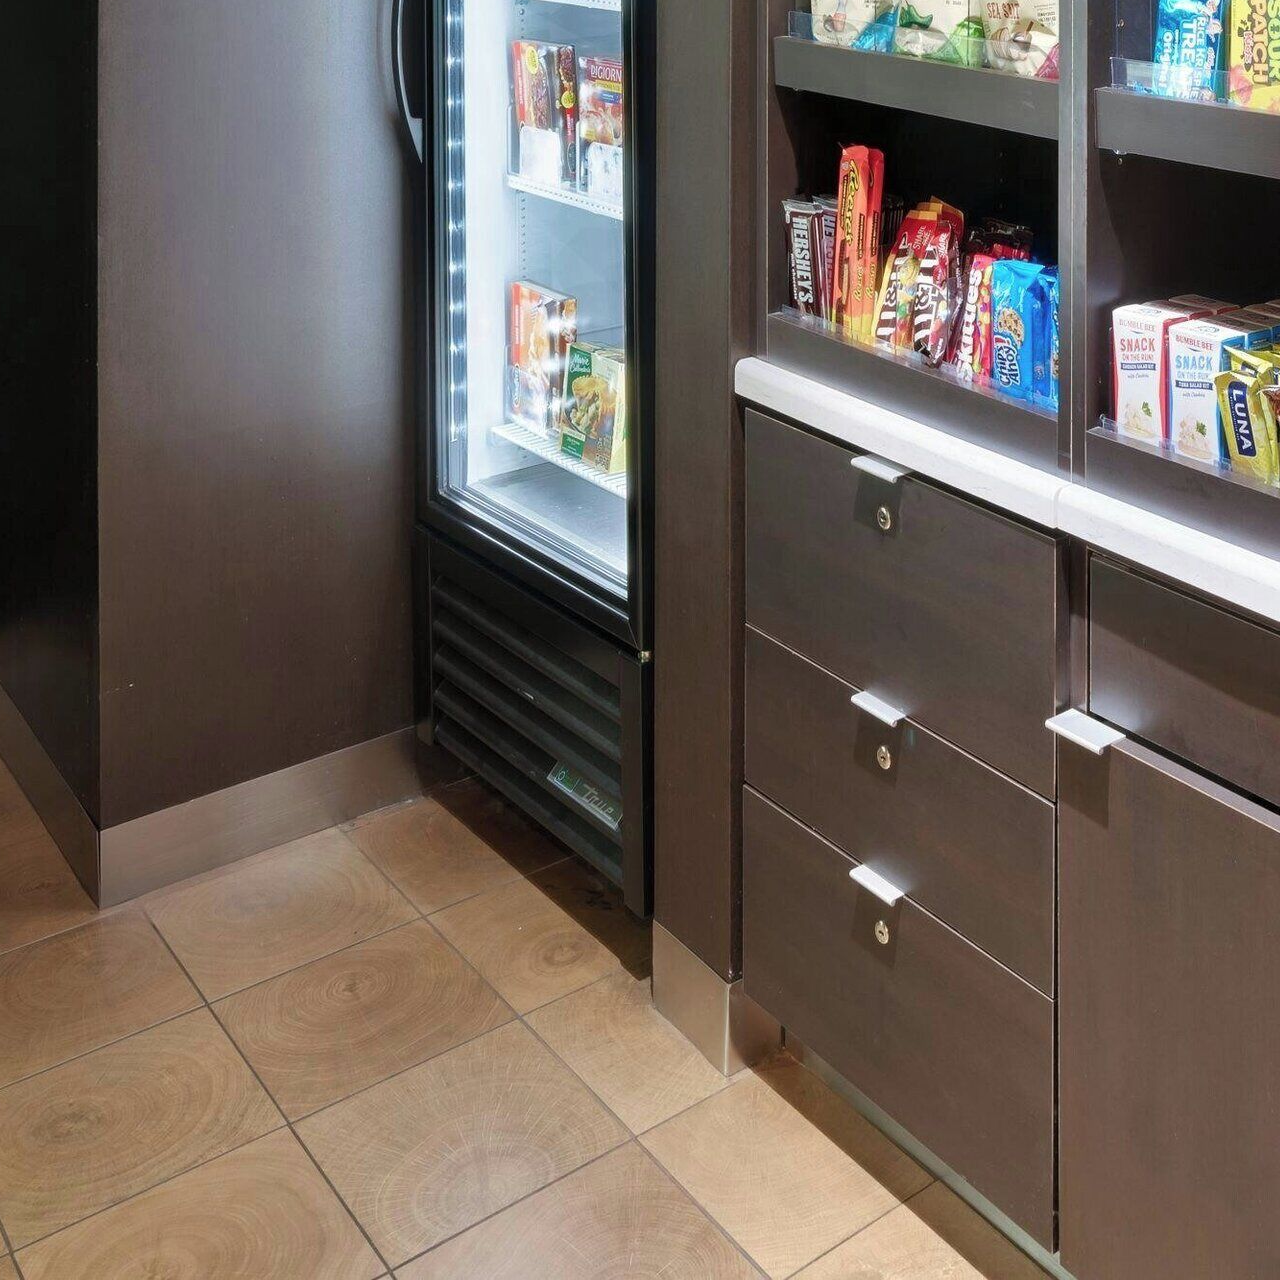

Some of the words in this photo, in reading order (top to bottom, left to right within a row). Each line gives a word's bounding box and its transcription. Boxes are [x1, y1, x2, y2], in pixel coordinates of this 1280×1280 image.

[1196, 15, 1207, 46] RICE
[590, 63, 623, 82] DIGIORN
[792, 216, 814, 304] HERSHEY'S
[1120, 337, 1156, 352] SNACK
[1201, 340, 1214, 352] BEE
[1174, 354, 1213, 371] SNACK
[1232, 388, 1253, 451] LUNA
